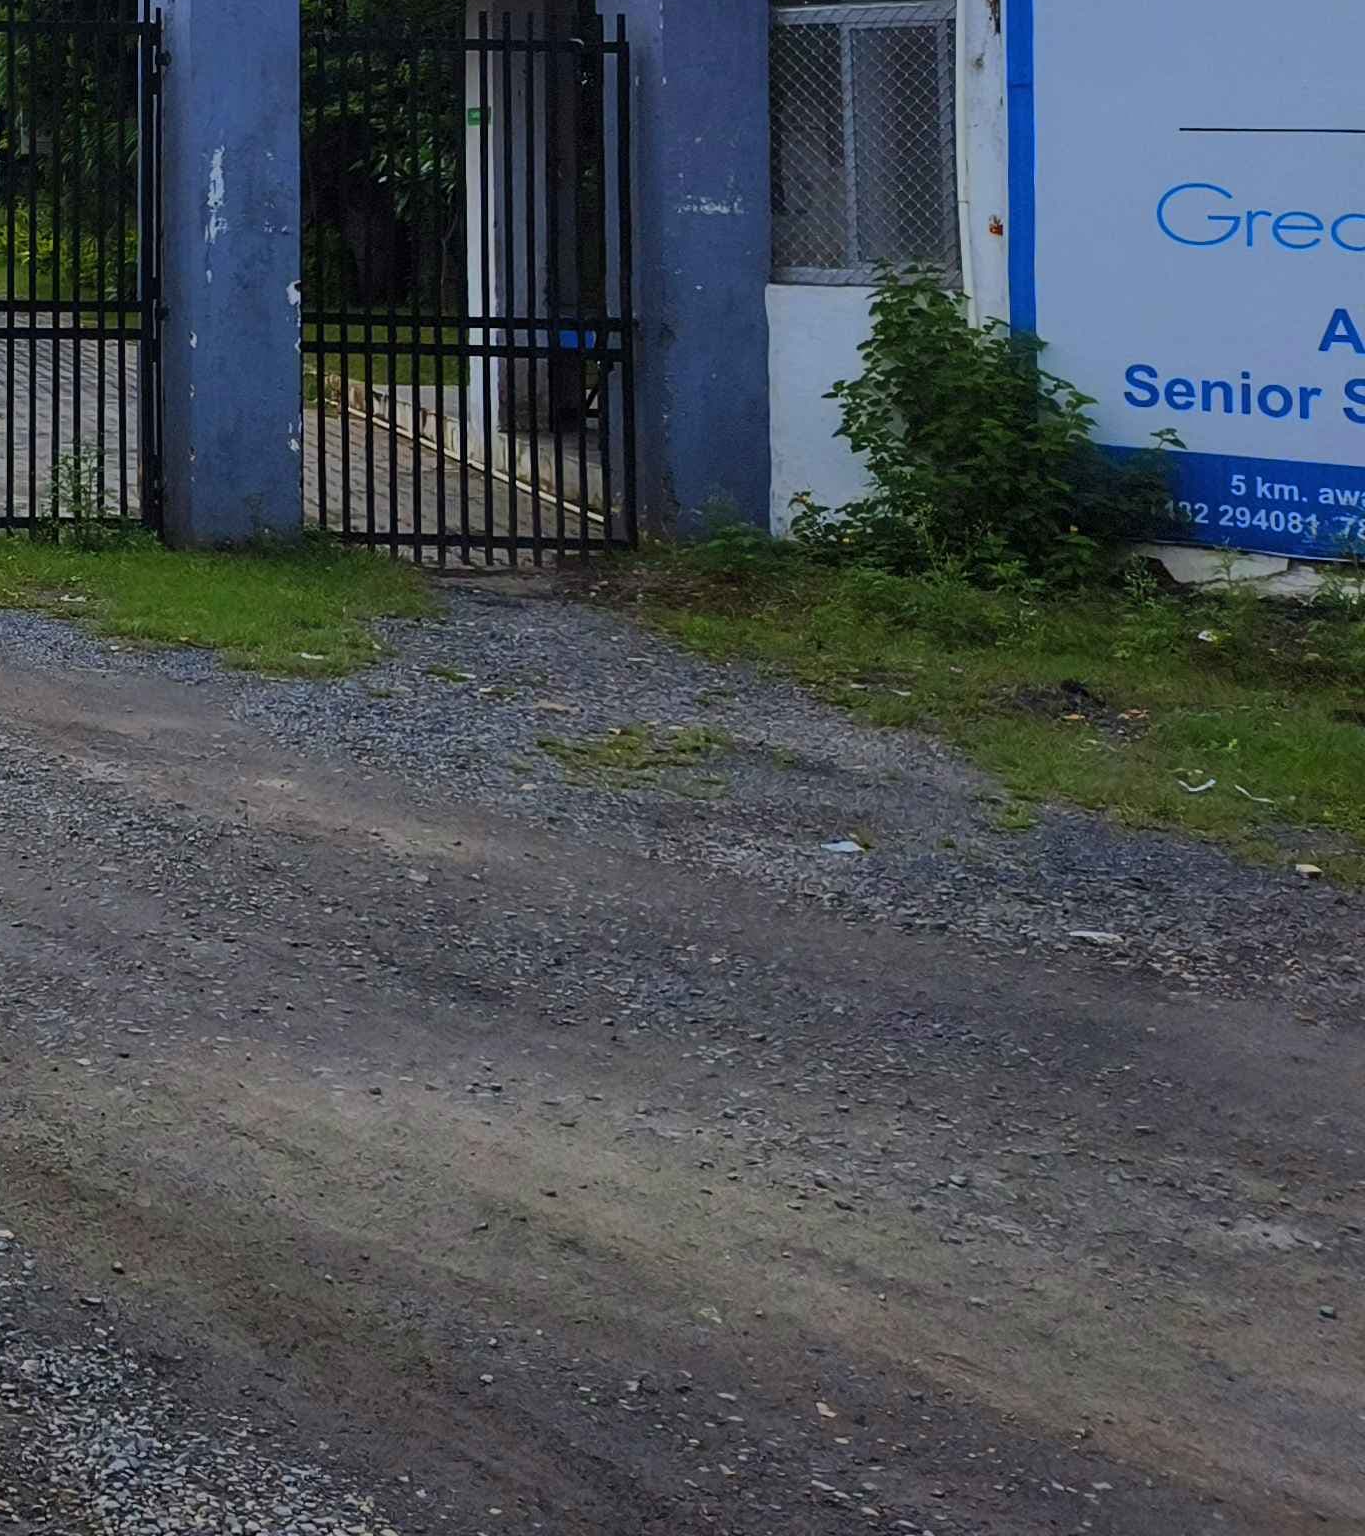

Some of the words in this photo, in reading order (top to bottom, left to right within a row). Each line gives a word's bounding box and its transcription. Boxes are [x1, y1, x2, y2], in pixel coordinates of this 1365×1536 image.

[1123, 363, 1322, 420] Senior
[1230, 474, 1246, 496] 5
[1256, 476, 1308, 503] km.
[1318, 487, 1365, 507] aw
